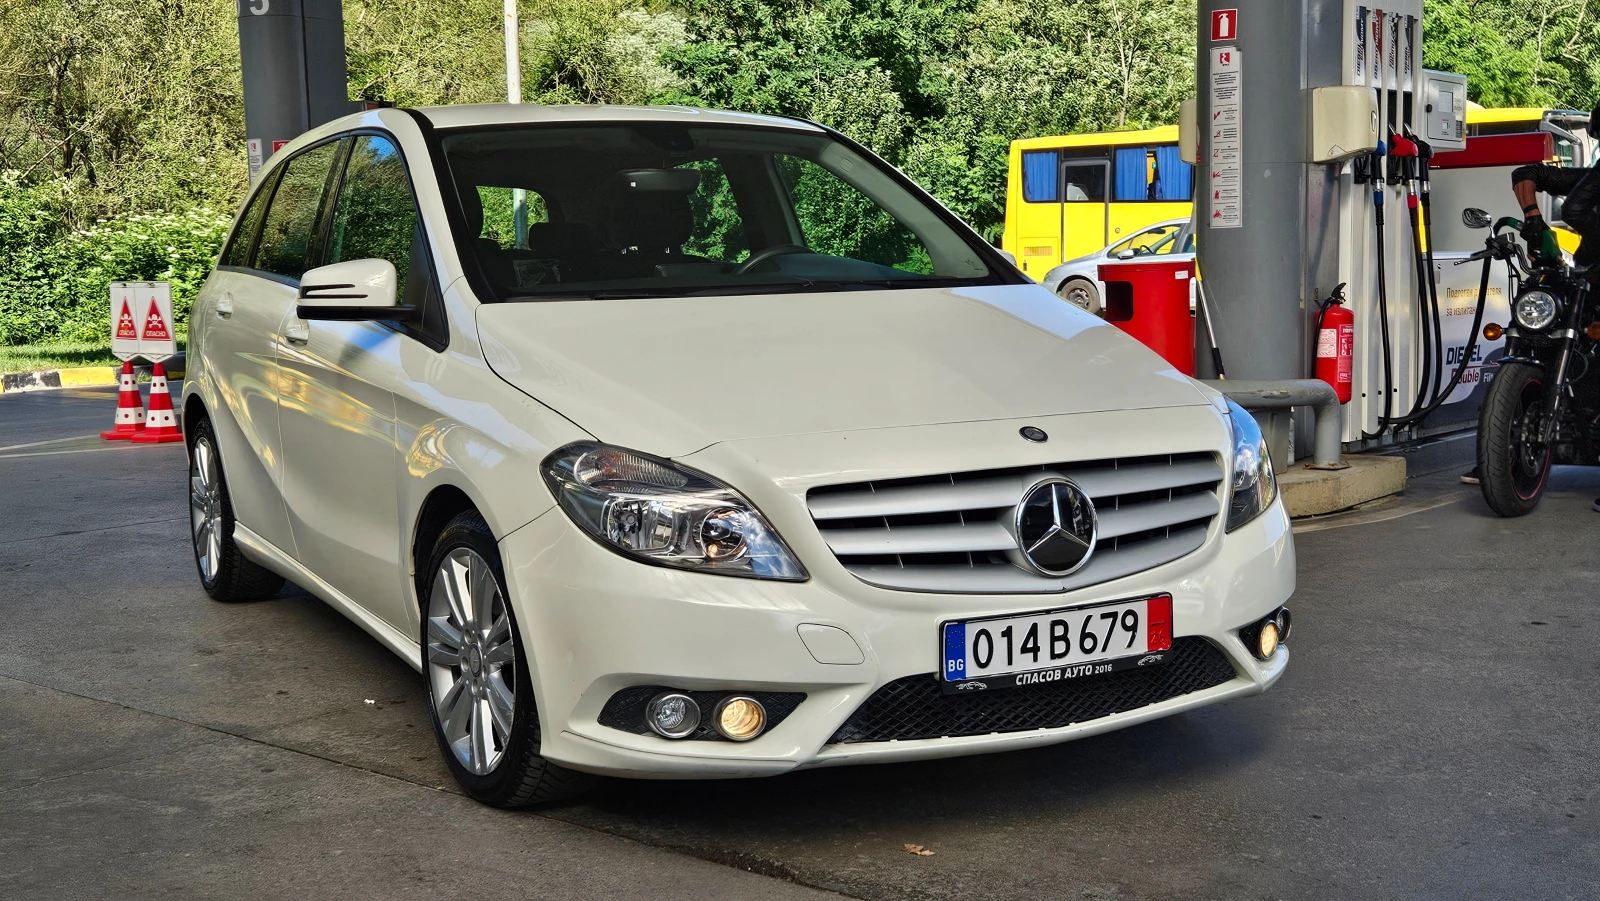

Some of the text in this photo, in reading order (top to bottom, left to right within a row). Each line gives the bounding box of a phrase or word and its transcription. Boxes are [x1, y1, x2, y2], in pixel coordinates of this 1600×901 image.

[1446, 345, 1482, 365] DIEEL
[948, 659, 964, 672] BG
[1015, 664, 1113, 686] СПАСОВ АУТО 2016
